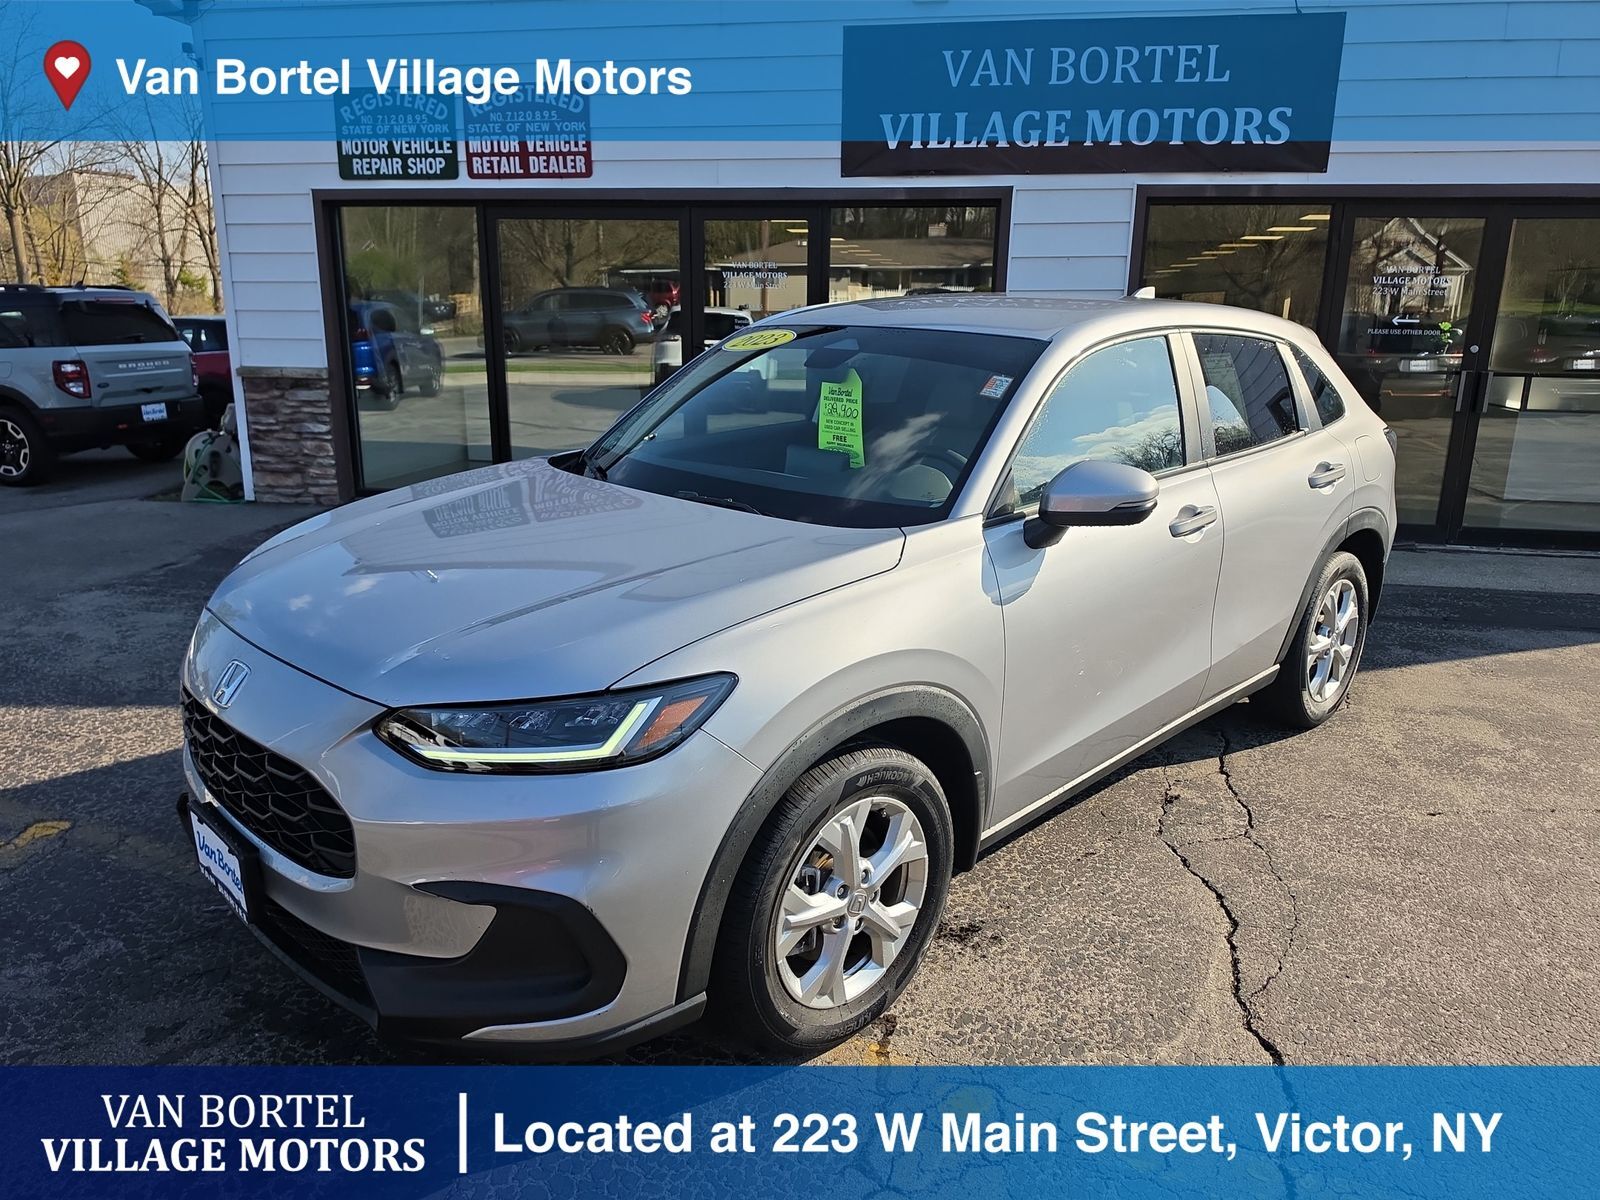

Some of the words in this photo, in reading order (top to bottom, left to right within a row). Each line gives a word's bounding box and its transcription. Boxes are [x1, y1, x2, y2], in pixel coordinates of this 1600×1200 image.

[942, 48, 1034, 87] VAN
[1048, 44, 1231, 85] BORTEL
[340, 89, 448, 123] REGISTERED
[506, 111, 558, 121] 7120895
[342, 125, 373, 134] STATE
[376, 125, 391, 134] OF
[393, 124, 413, 134] NEW
[421, 124, 449, 133] YORK
[467, 123, 502, 133] STATE
[506, 123, 520, 132] OF
[526, 122, 550, 132] NEW
[555, 121, 586, 131] YORK
[879, 110, 1072, 150] VILLAGE
[1084, 106, 1293, 146] MOTORS
[341, 138, 388, 155] MOTOR
[392, 137, 453, 154] VEHICLE
[468, 135, 520, 153] MOTOR
[526, 134, 587, 152] VEHICLE
[352, 158, 403, 175] REPAIR
[407, 157, 446, 175] SHOP
[472, 156, 523, 174] RETAIL
[529, 155, 586, 173] DEALER
[1373, 276, 1411, 284] VILLAGE
[1412, 277, 1452, 285] MOTORS
[1373, 287, 1388, 295] 223
[1389, 287, 1399, 295] W
[1401, 287, 1421, 295] Main
[1422, 288, 1448, 296] Street
[118, 361, 170, 369] BRONCO
[832, 435, 847, 443] FREE
